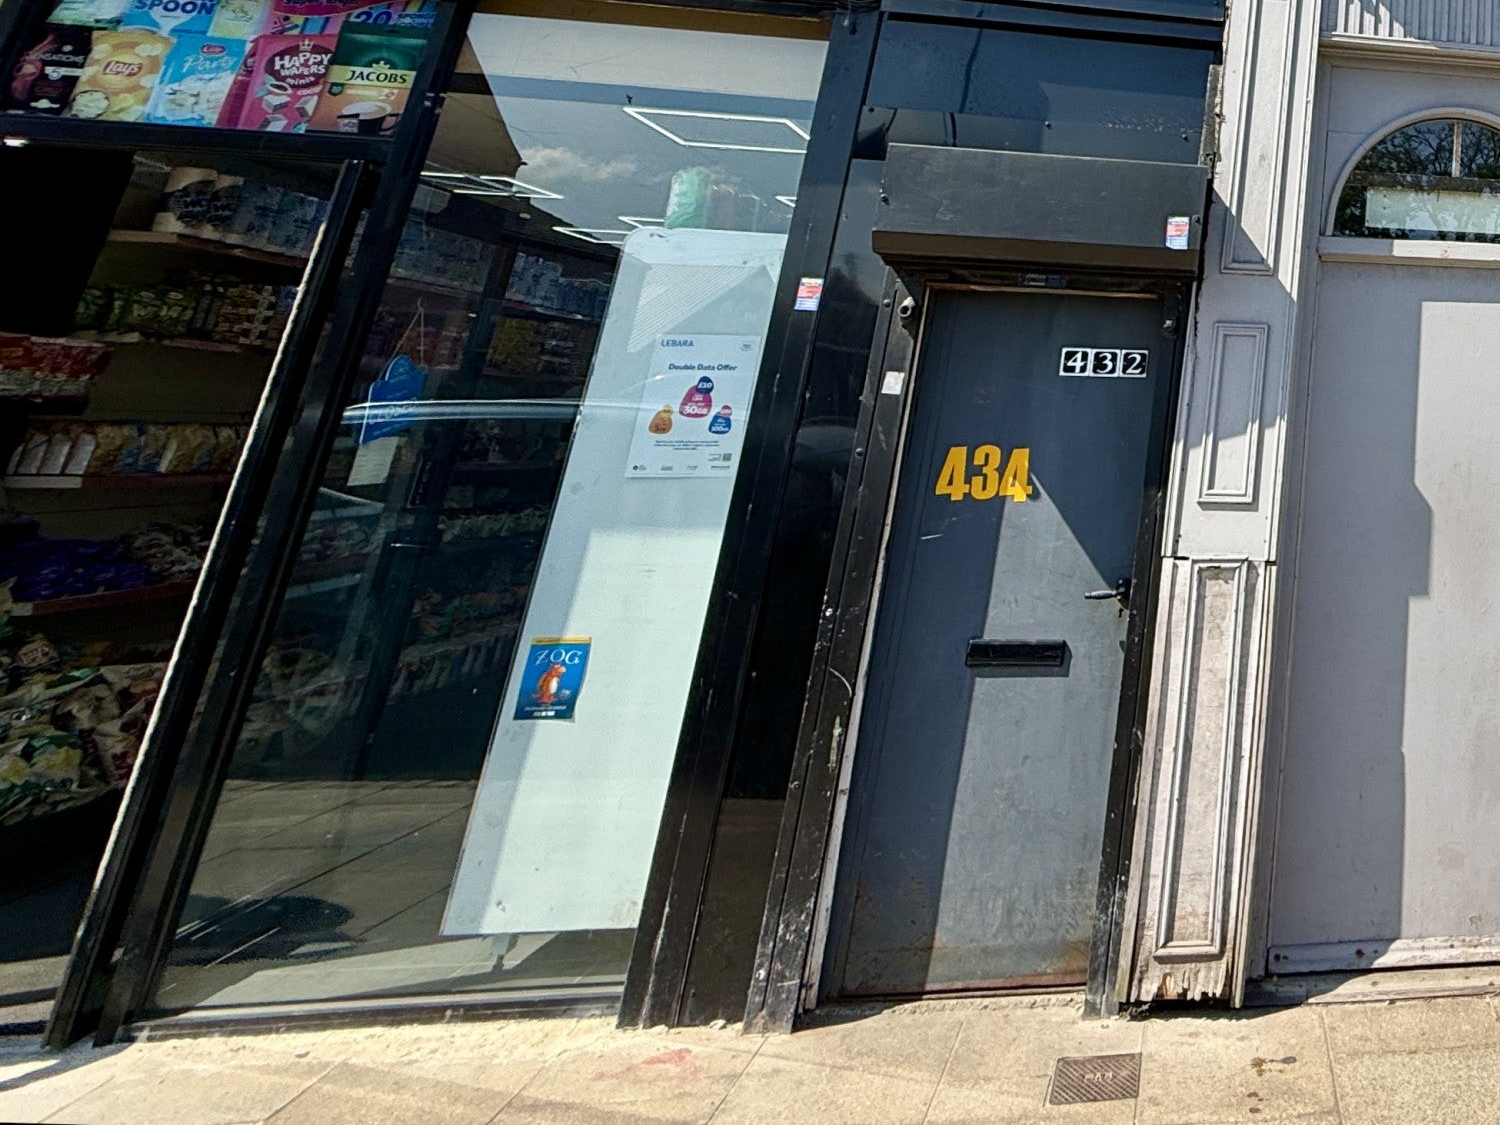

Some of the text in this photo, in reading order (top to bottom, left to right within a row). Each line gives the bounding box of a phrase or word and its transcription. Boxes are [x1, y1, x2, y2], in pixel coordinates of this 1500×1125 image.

[274, 52, 333, 70] HAPPY
[280, 64, 326, 76] WAFERS
[345, 70, 408, 84] JACOBS
[661, 339, 694, 348] LEBARA
[668, 363, 696, 371] Double
[1063, 351, 1145, 375] 432
[935, 444, 1033, 503] 434
[535, 648, 582, 665] ZOG
